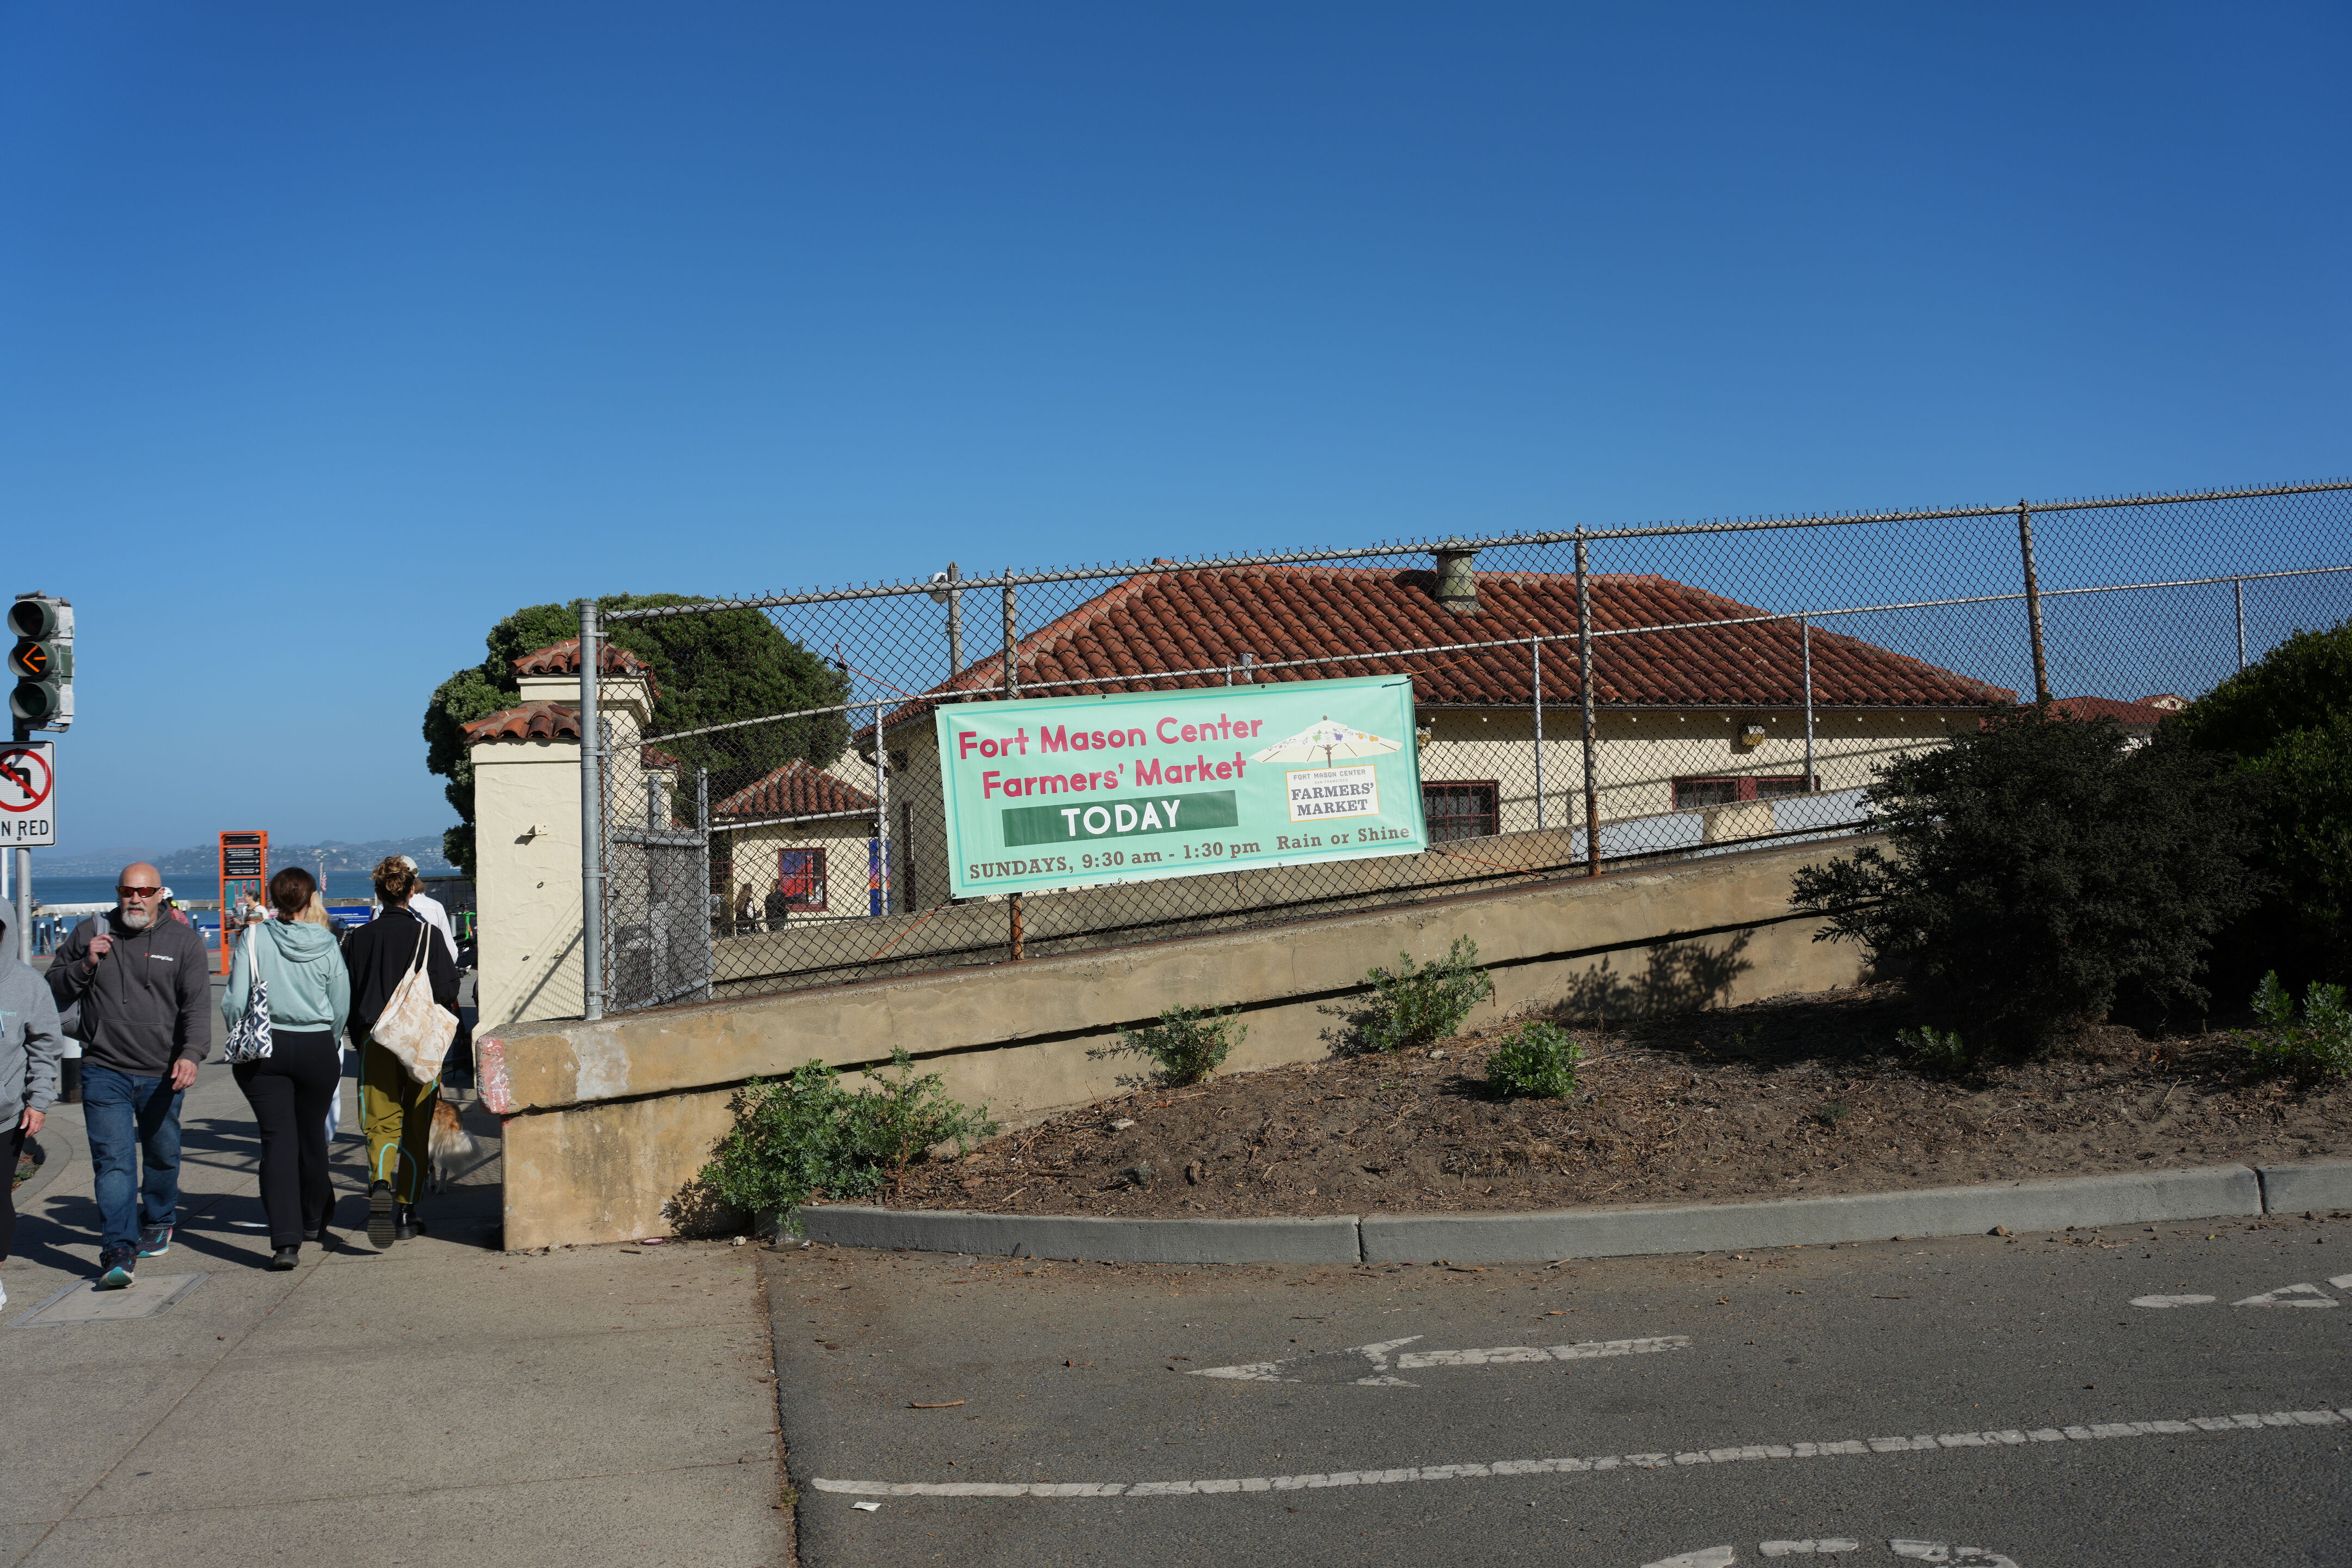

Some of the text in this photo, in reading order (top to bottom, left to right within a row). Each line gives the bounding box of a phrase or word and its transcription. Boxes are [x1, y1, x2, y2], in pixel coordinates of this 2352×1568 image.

[959, 714, 1263, 759] Fort Mason Center
[1136, 752, 1246, 786] Market
[1061, 799, 1180, 837] TODAY
[1297, 799, 1368, 816] MARKET
[1, 820, 48, 836] N RED
[969, 856, 1074, 880] SUNDAYS,
[1082, 851, 1125, 869] 9:30
[1131, 852, 1163, 865] am
[1183, 842, 1223, 860] 1:30
[1229, 842, 1261, 859] pm
[1277, 834, 1322, 850] Rain
[1331, 834, 1350, 845] or
[1358, 825, 1410, 842] Shine
